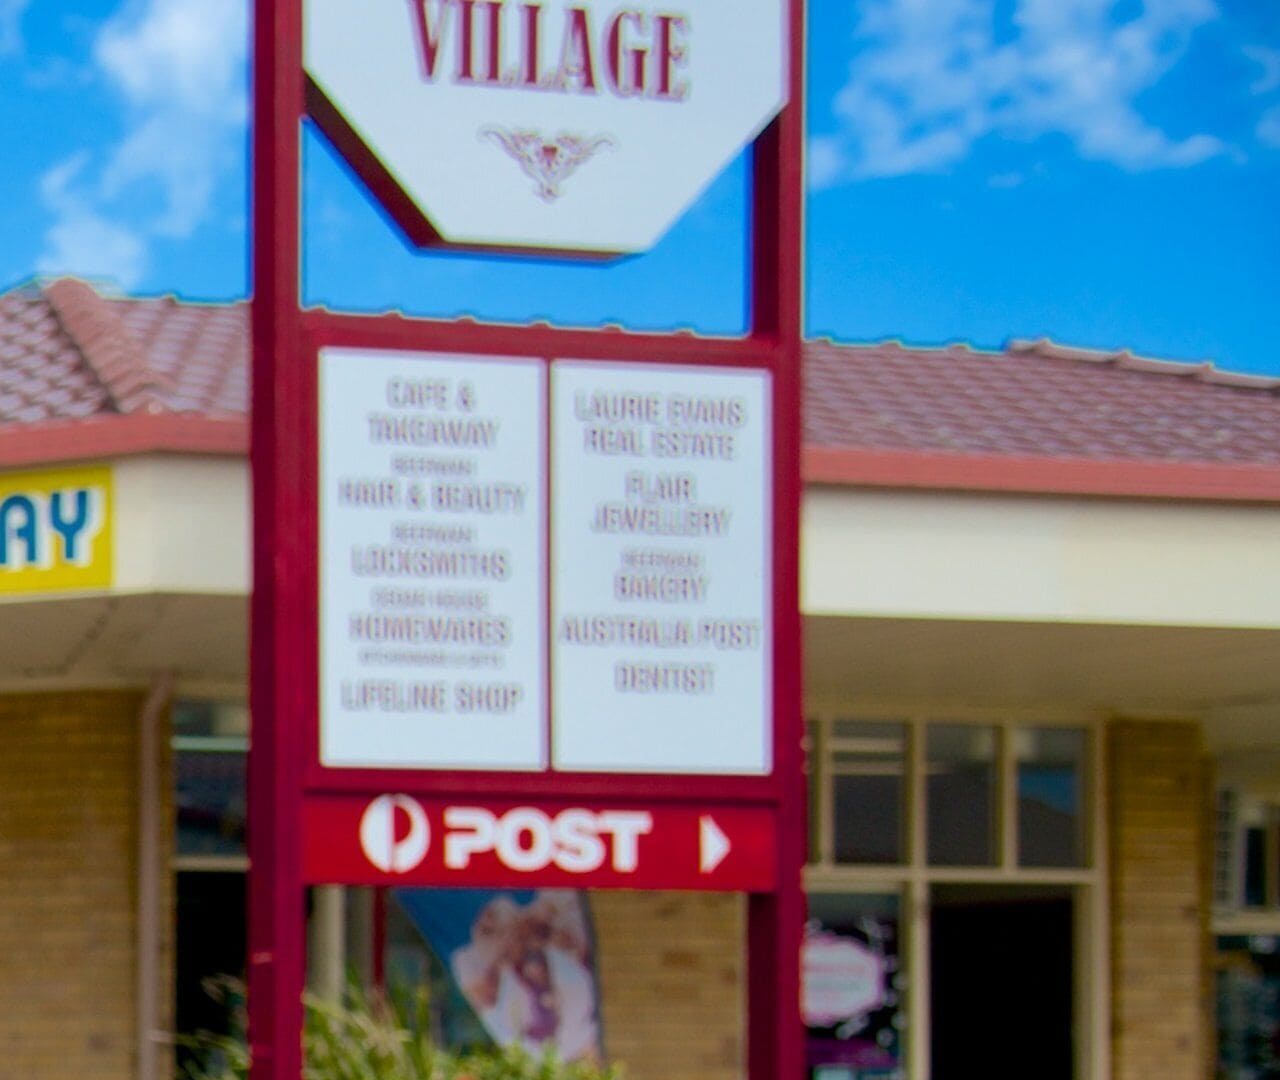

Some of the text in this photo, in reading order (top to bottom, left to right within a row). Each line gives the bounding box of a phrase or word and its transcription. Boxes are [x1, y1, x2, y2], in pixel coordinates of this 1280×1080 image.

[407, 0, 690, 102] VILLAGE
[387, 376, 452, 408] CAFE
[575, 390, 747, 428] LAURIE EVANS
[364, 412, 500, 447] TAKEAWAY
[584, 424, 740, 460] REAL ESTATE
[338, 477, 401, 508] HAIR
[430, 480, 528, 513] BEAUTY
[625, 470, 697, 504] FLAIR
[589, 502, 733, 537] JEWELLERY
[349, 544, 513, 581] LOCKSMITHS
[613, 570, 710, 604] BAKERY
[348, 613, 513, 647] HOMEWARES
[558, 614, 762, 650] AUSTRALIA POST
[614, 660, 718, 694] DENTIST
[341, 680, 524, 714] LIFELINE SHOP
[443, 806, 654, 872] POST
